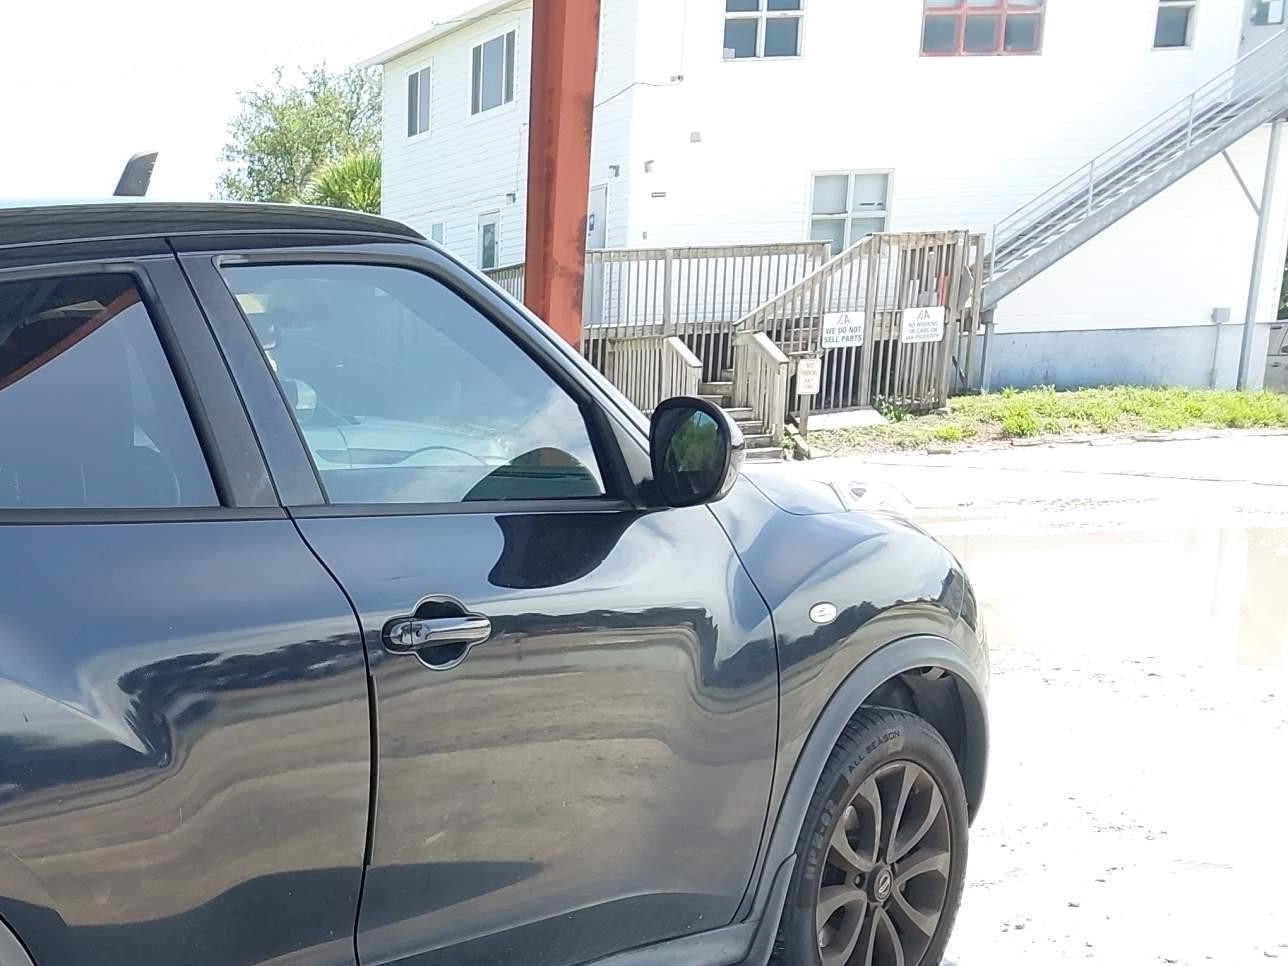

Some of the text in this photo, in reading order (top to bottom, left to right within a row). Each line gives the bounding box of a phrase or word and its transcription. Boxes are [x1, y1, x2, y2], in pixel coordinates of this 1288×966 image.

[825, 325, 862, 335] WE DO NOT
[824, 334, 863, 344] SELL PARTS
[848, 730, 900, 774] ALL SEASON
